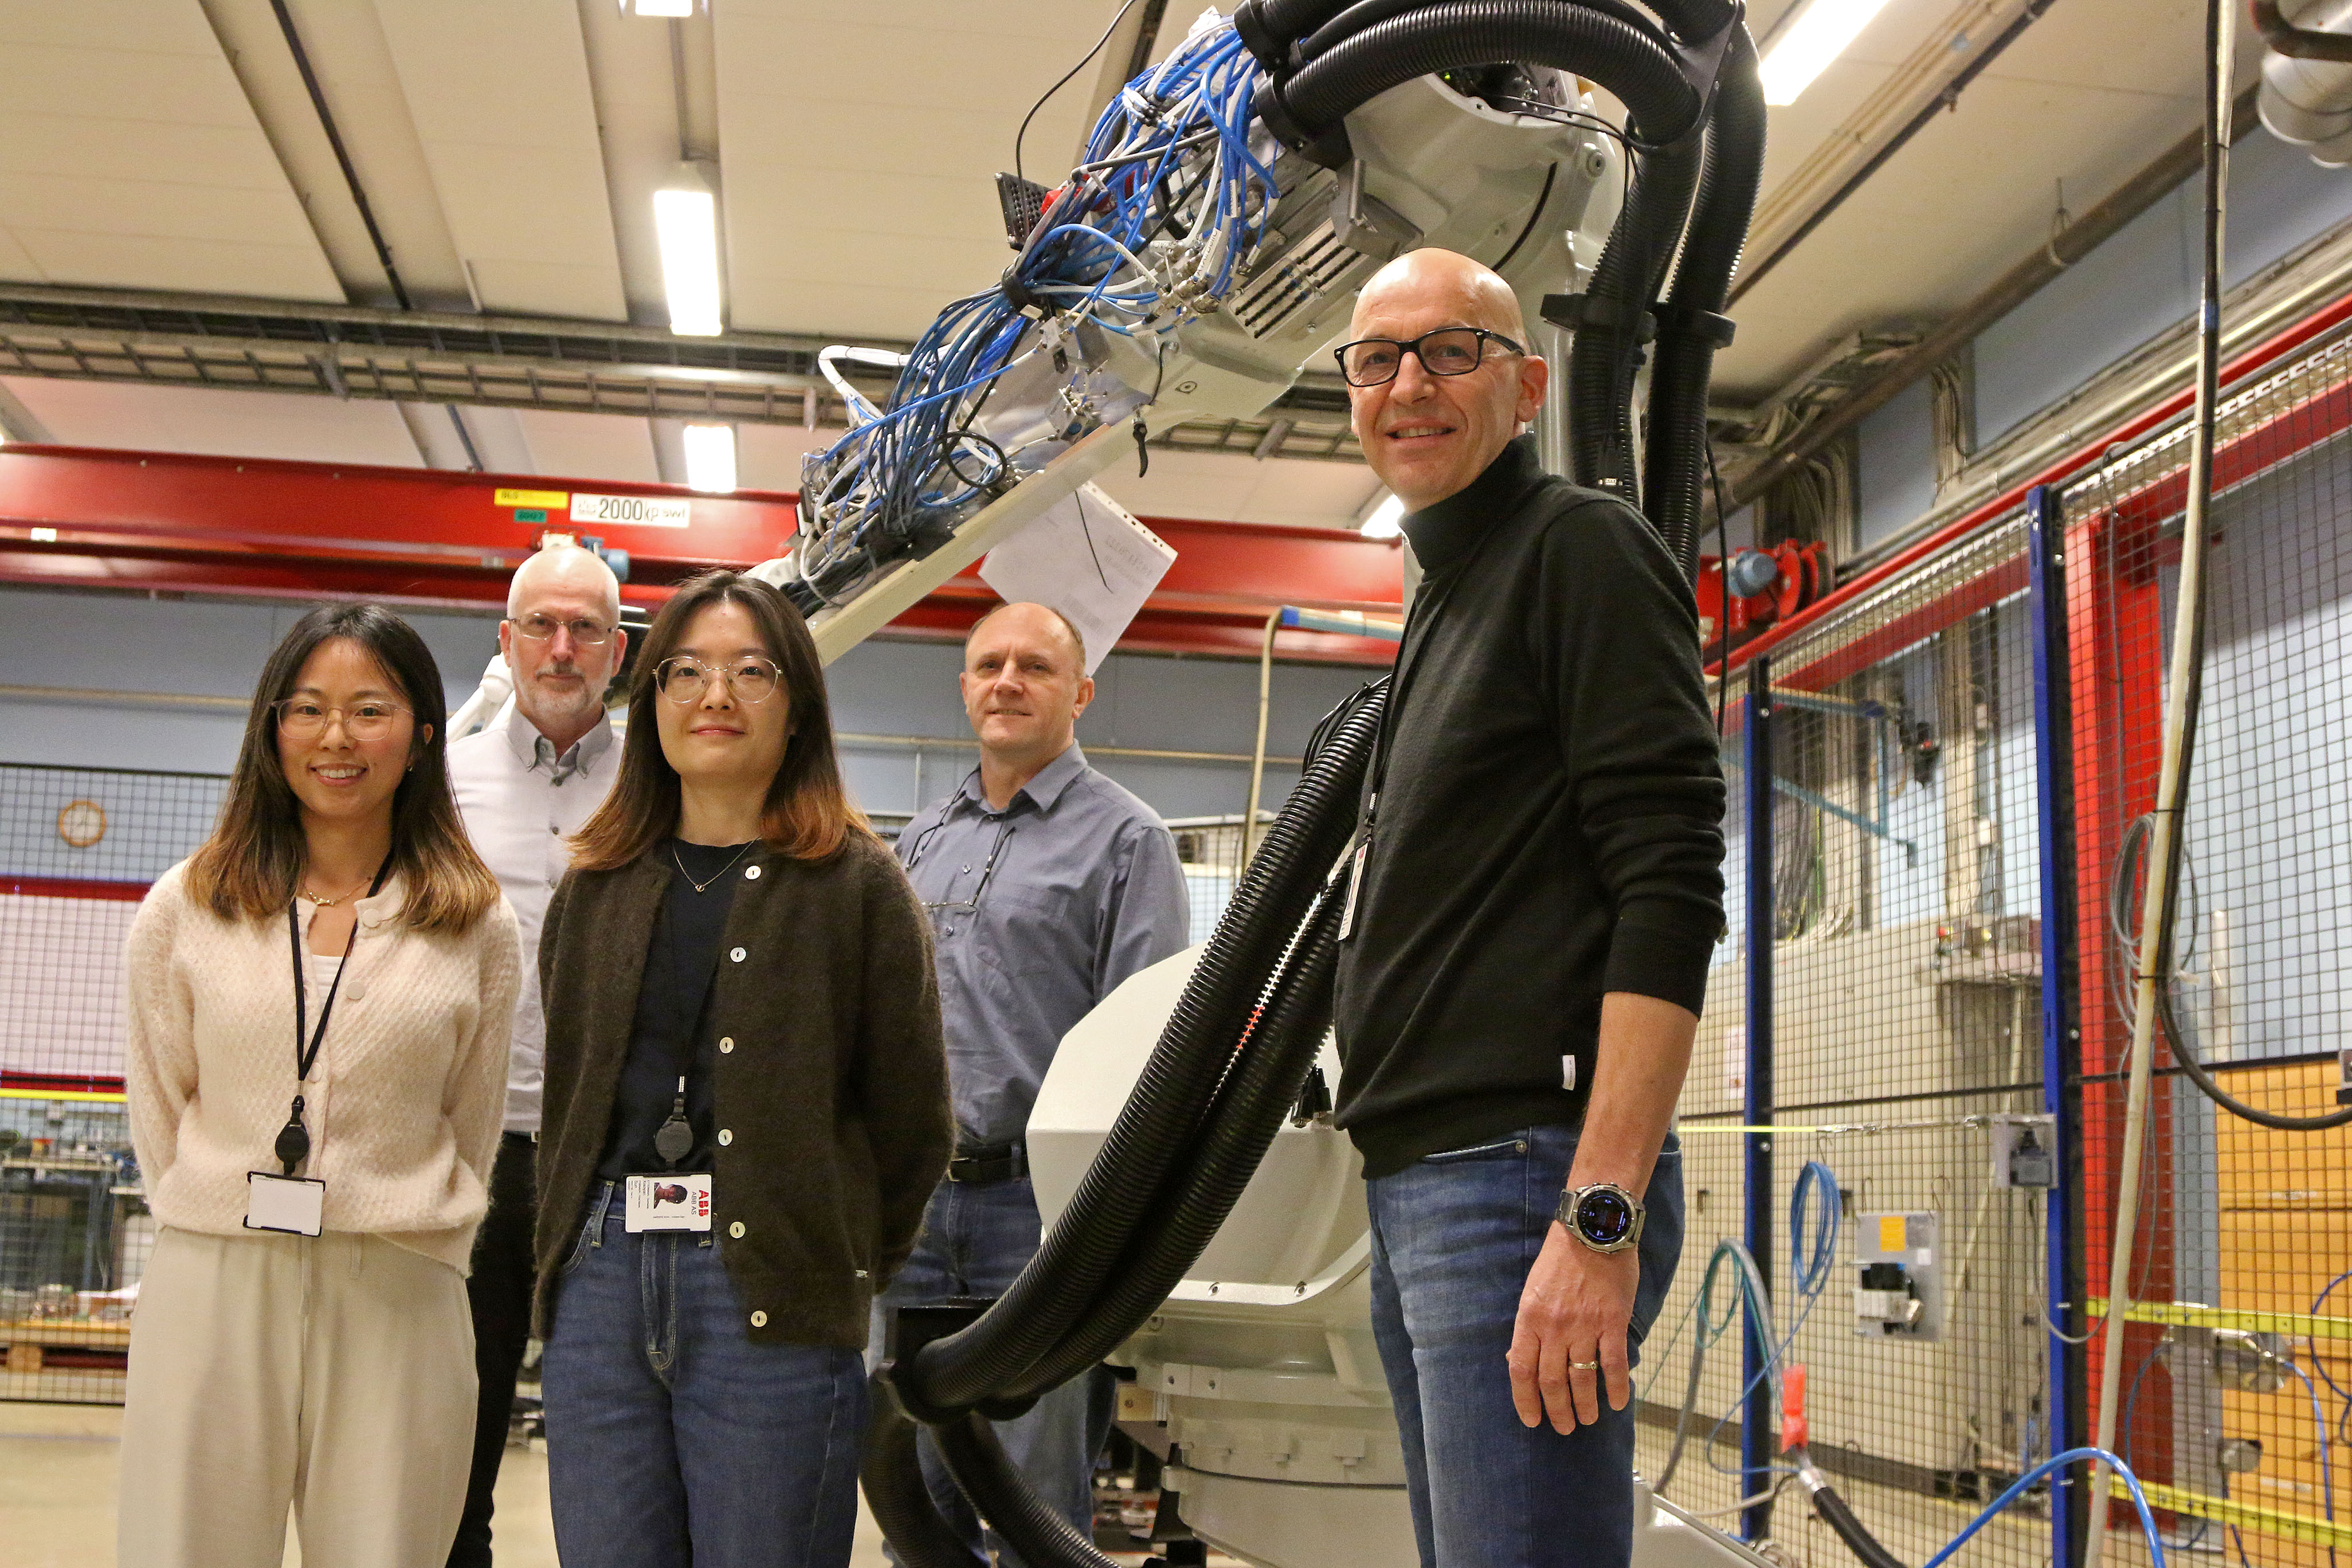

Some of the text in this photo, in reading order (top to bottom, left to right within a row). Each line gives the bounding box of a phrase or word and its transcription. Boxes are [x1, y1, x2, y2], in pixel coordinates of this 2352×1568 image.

[598, 497, 643, 521] 2000
[691, 1206, 696, 1215] AS
[698, 1189, 709, 1217] ABB
